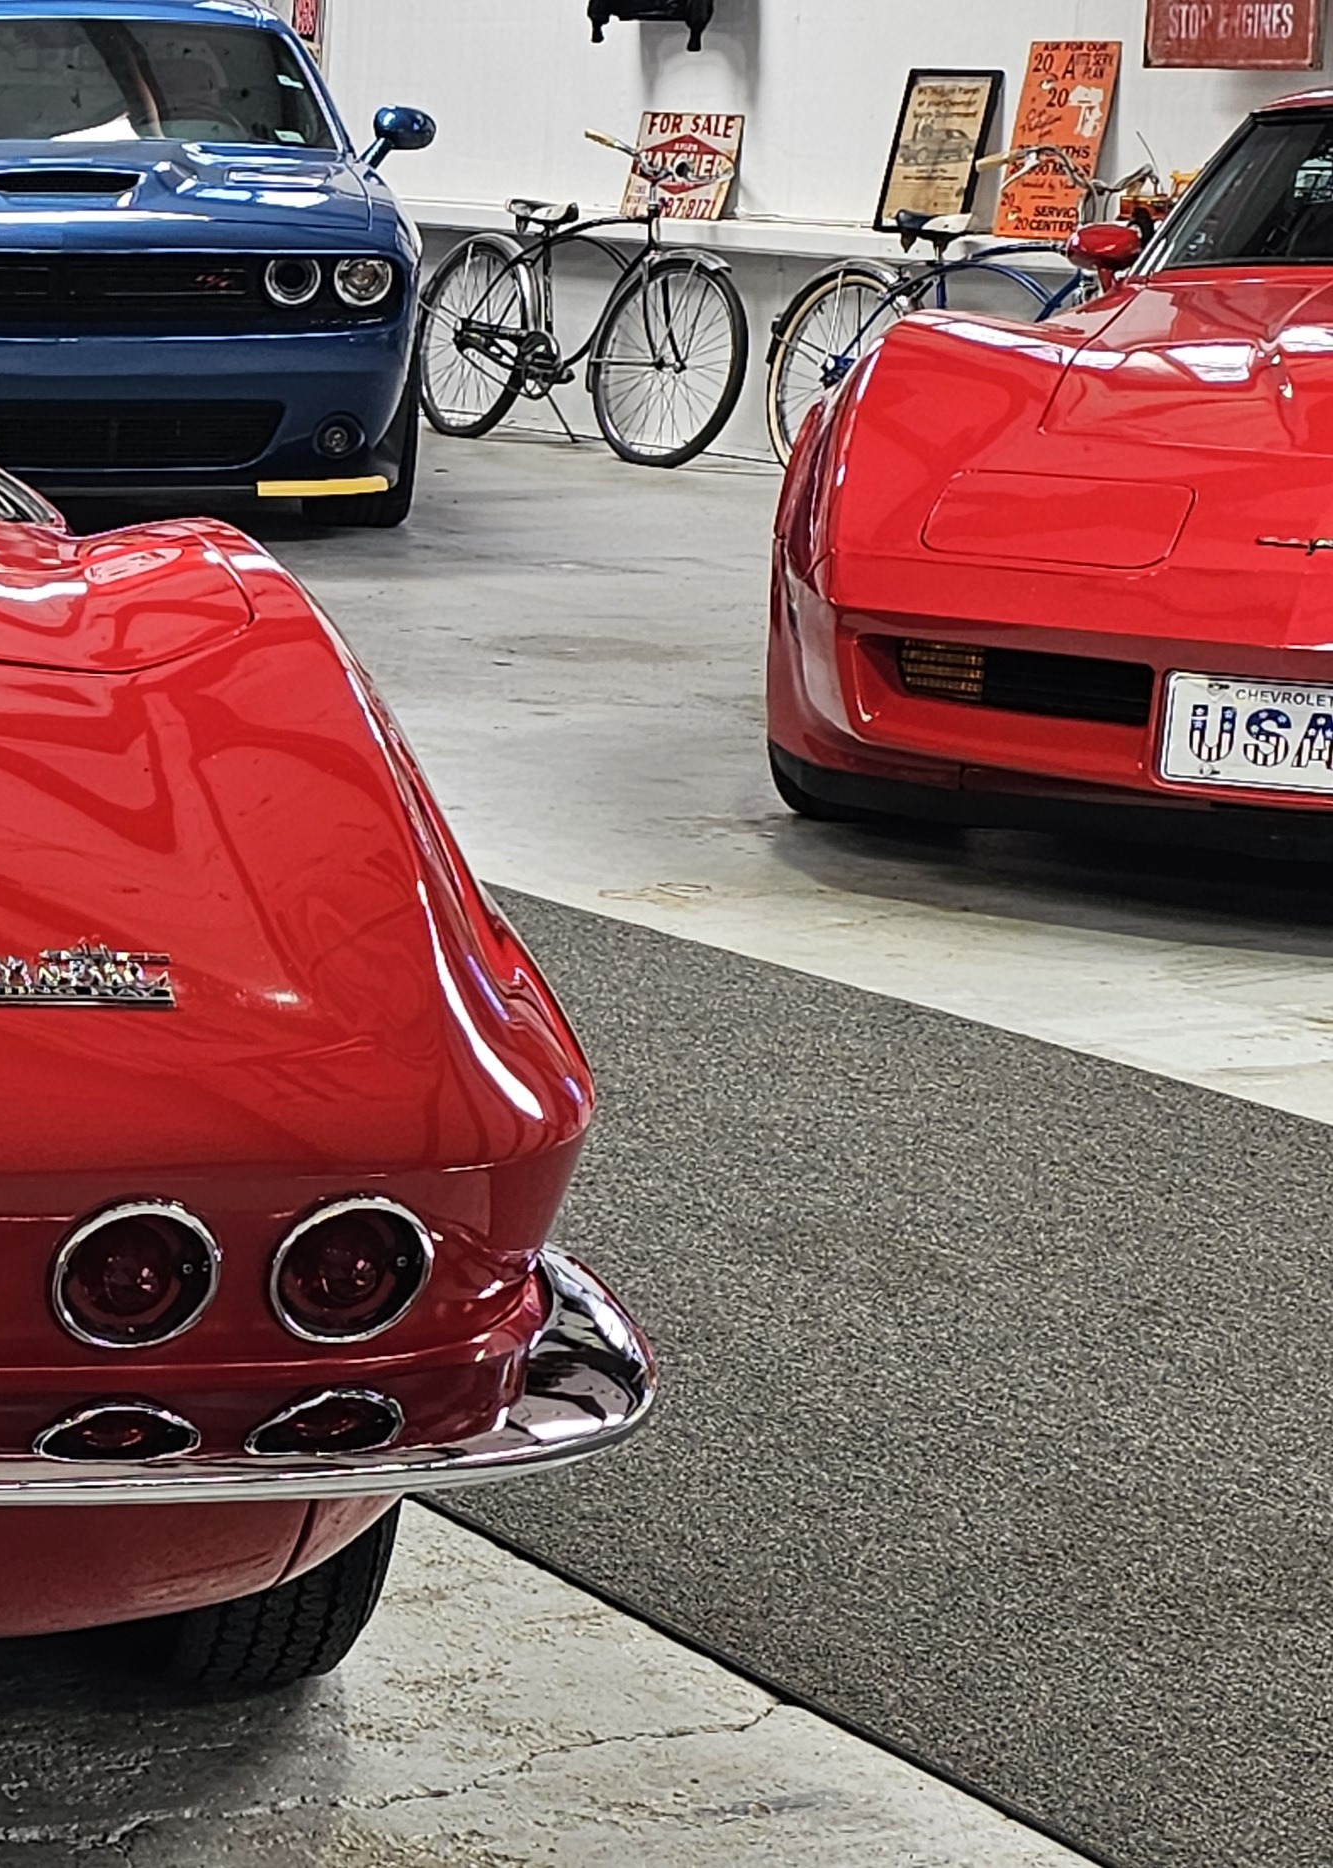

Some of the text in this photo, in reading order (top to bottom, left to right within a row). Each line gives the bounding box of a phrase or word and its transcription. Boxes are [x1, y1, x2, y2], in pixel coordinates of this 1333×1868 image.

[1168, 3, 1294, 39] STOP ENGINES
[1032, 52, 1055, 73] 20
[1046, 87, 1070, 108] 20
[648, 115, 735, 138] FOR SALE
[1033, 205, 1079, 219] SERVIC
[1235, 689, 1333, 707] CHEVROLET
[1189, 704, 1333, 772] USA
